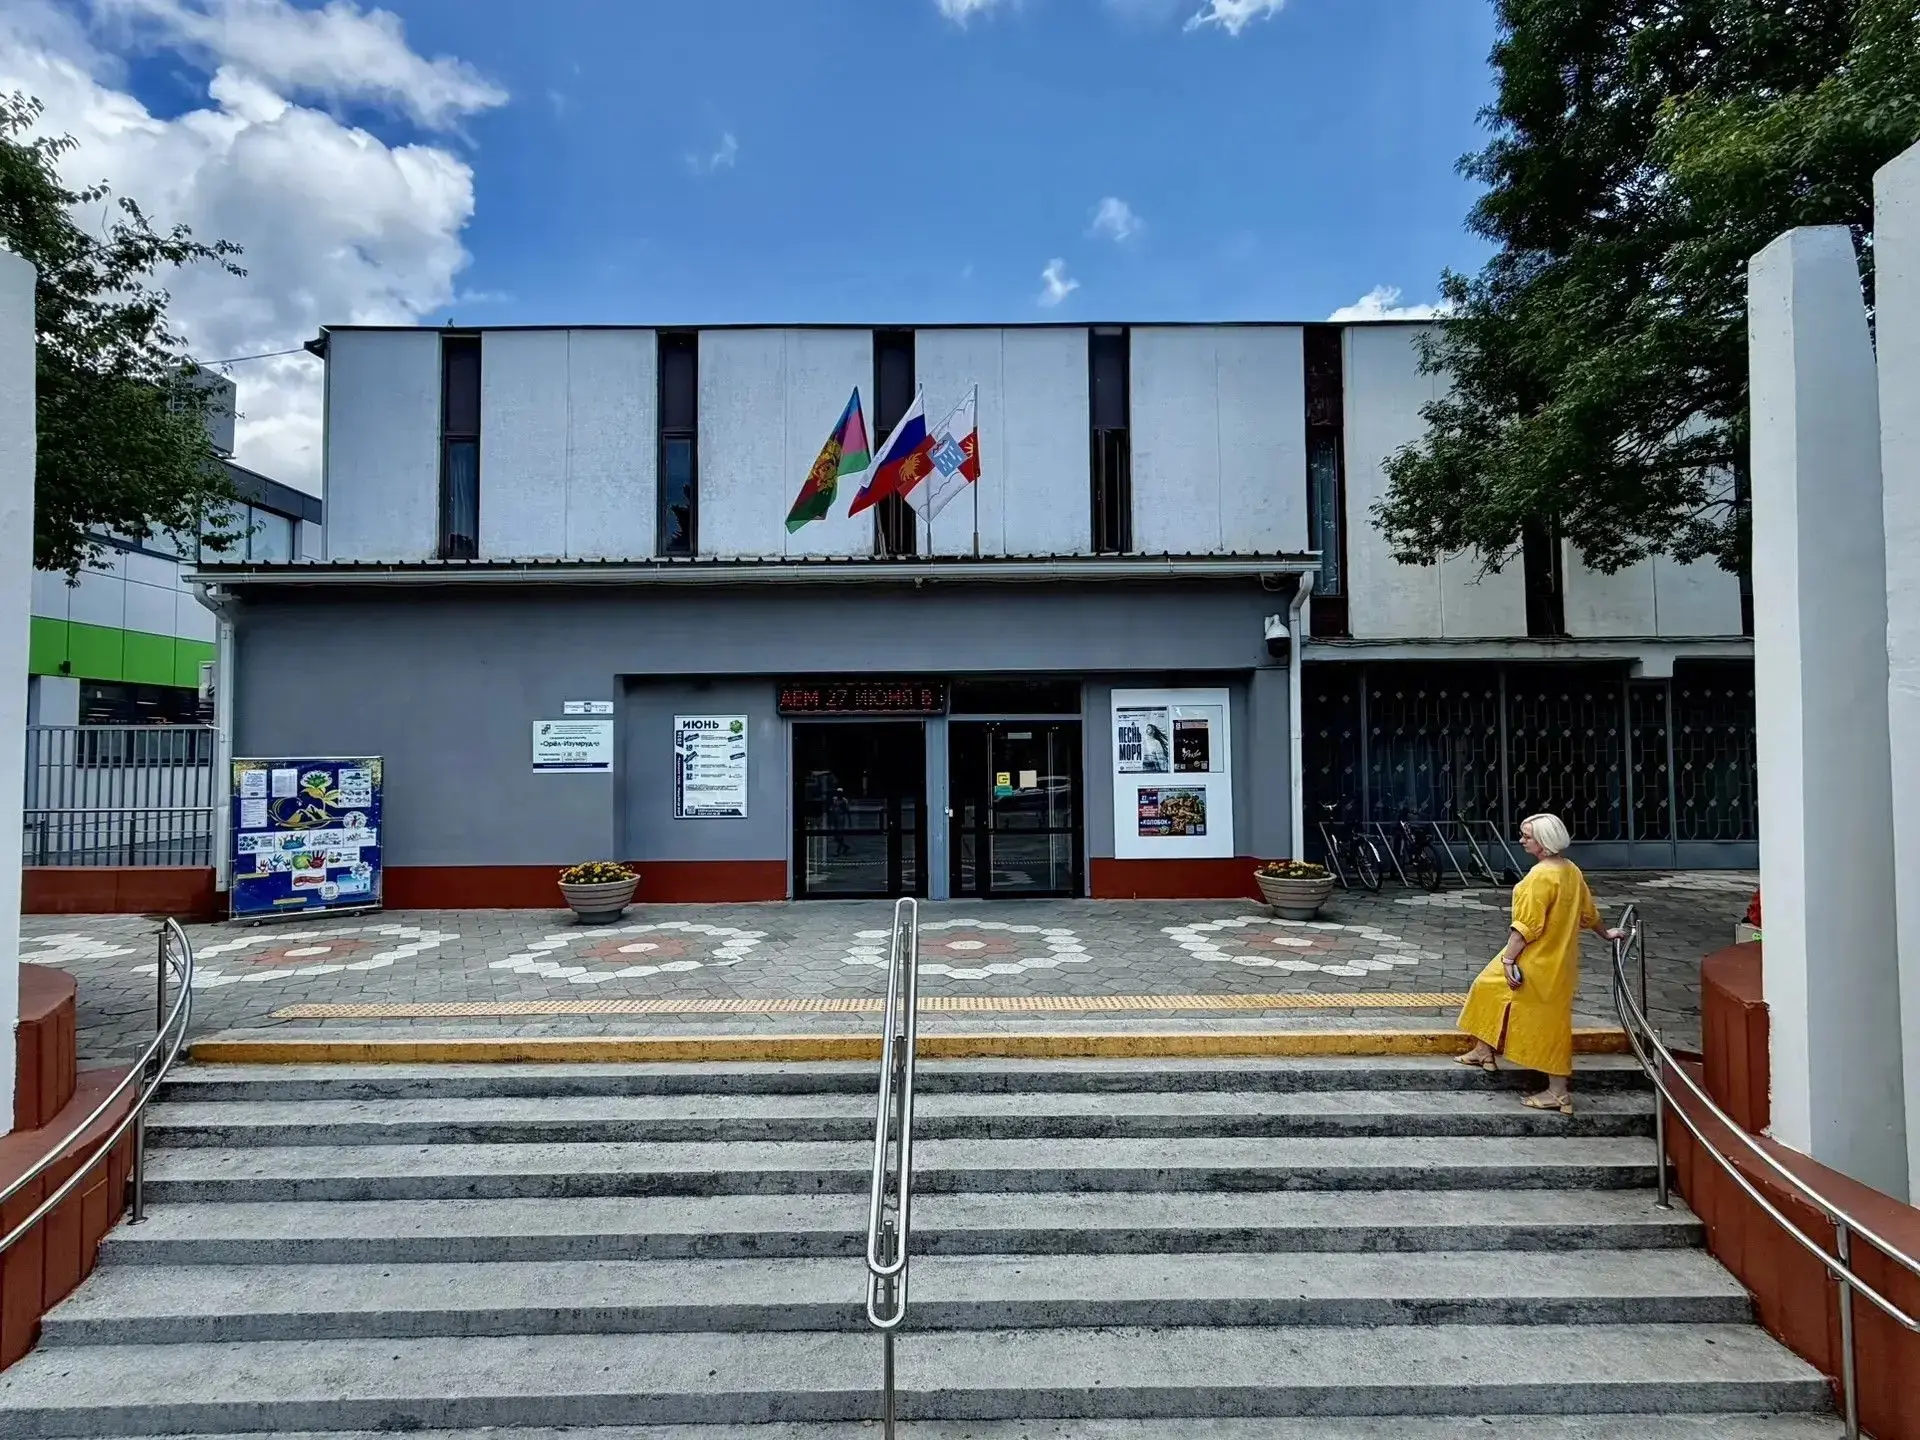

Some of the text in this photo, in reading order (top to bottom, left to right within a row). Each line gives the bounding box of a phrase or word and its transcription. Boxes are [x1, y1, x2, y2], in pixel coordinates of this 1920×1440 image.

[826, 689, 848, 706] 27
[855, 689, 913, 706] ИЮНЯ
[921, 689, 933, 706] В
[682, 720, 720, 729] ИЮНЬ
[1118, 727, 1142, 743] ПЕСНЬ
[1119, 744, 1142, 761] МОРЯ
